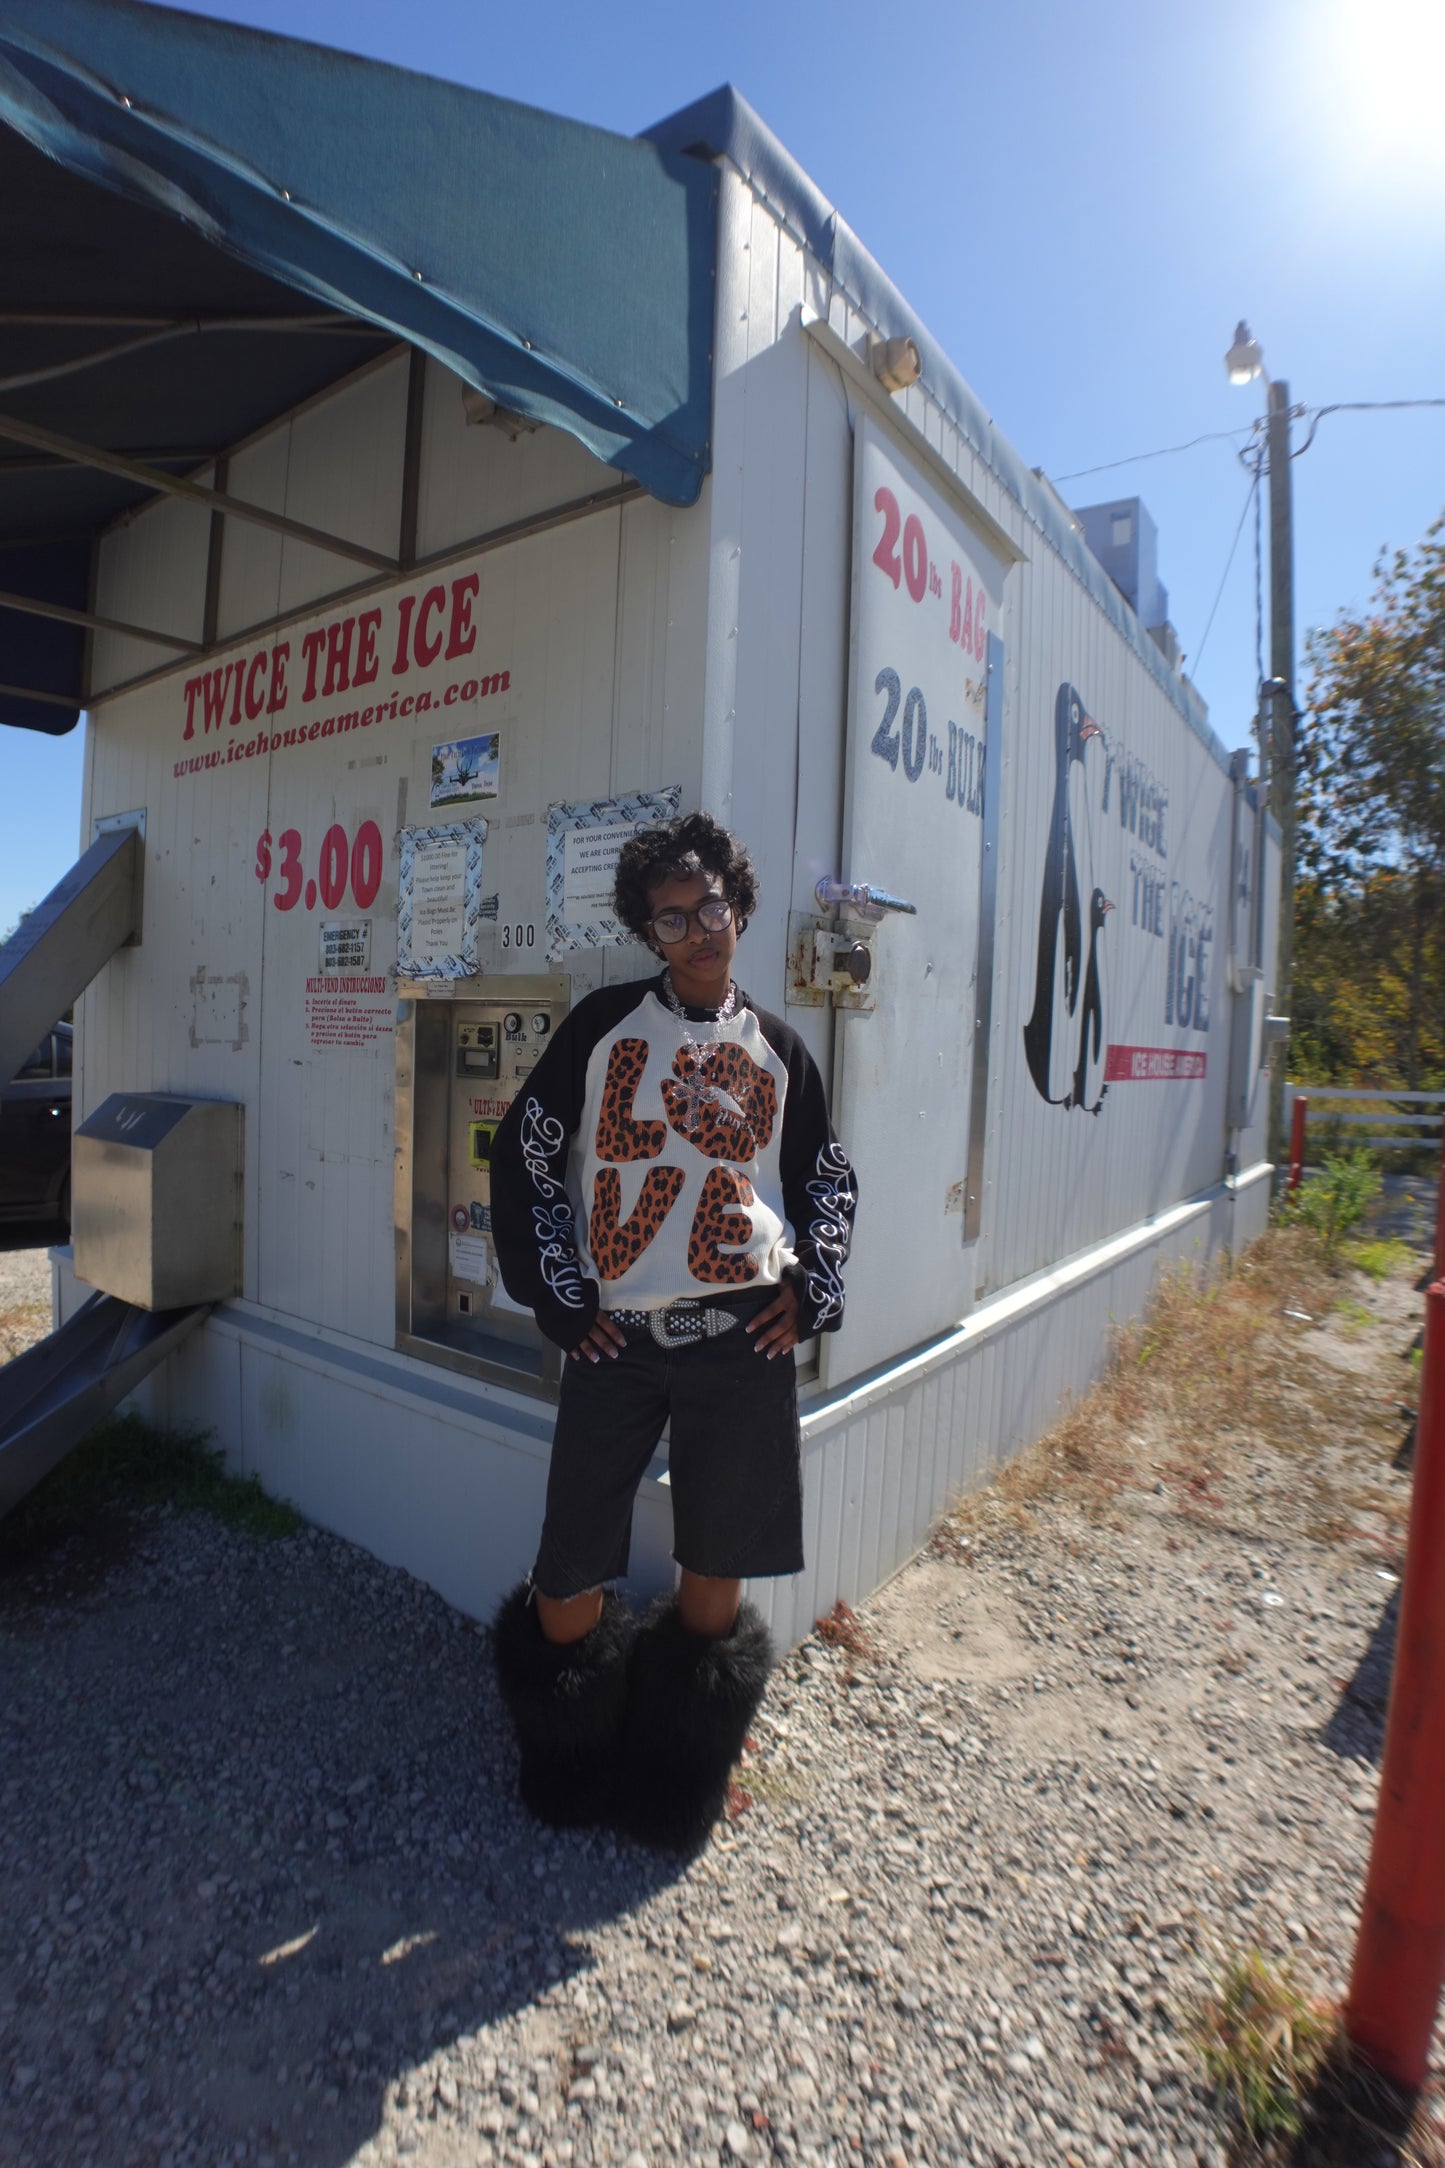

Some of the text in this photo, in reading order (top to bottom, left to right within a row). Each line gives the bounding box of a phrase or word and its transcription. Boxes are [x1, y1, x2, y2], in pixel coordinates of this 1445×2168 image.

[872, 486, 928, 603] 20
[949, 559, 986, 662] BAG
[182, 572, 480, 741] TWICE THE ICE
[173, 669, 512, 779] www.icehouseamerica.com
[871, 666, 928, 783] 20
[945, 719, 987, 820] BULK
[1100, 730, 1168, 860] TWICE
[255, 819, 384, 912] $3.00
[573, 837, 585, 845] FOR
[585, 834, 602, 843] YOUR
[579, 851, 589, 859] WE
[590, 849, 601, 857] ARE
[571, 864, 602, 875] ACCEPTING
[1128, 849, 1167, 938] THE
[323, 929, 360, 941] EMERGENCY
[502, 924, 535, 948] 300
[1165, 880, 1214, 1033] ICE
[306, 977, 386, 993] MULTI-VEND INSTRUCCIONES
[505, 1031, 527, 1043] Bulk
[1131, 1051, 1148, 1078] ICE
